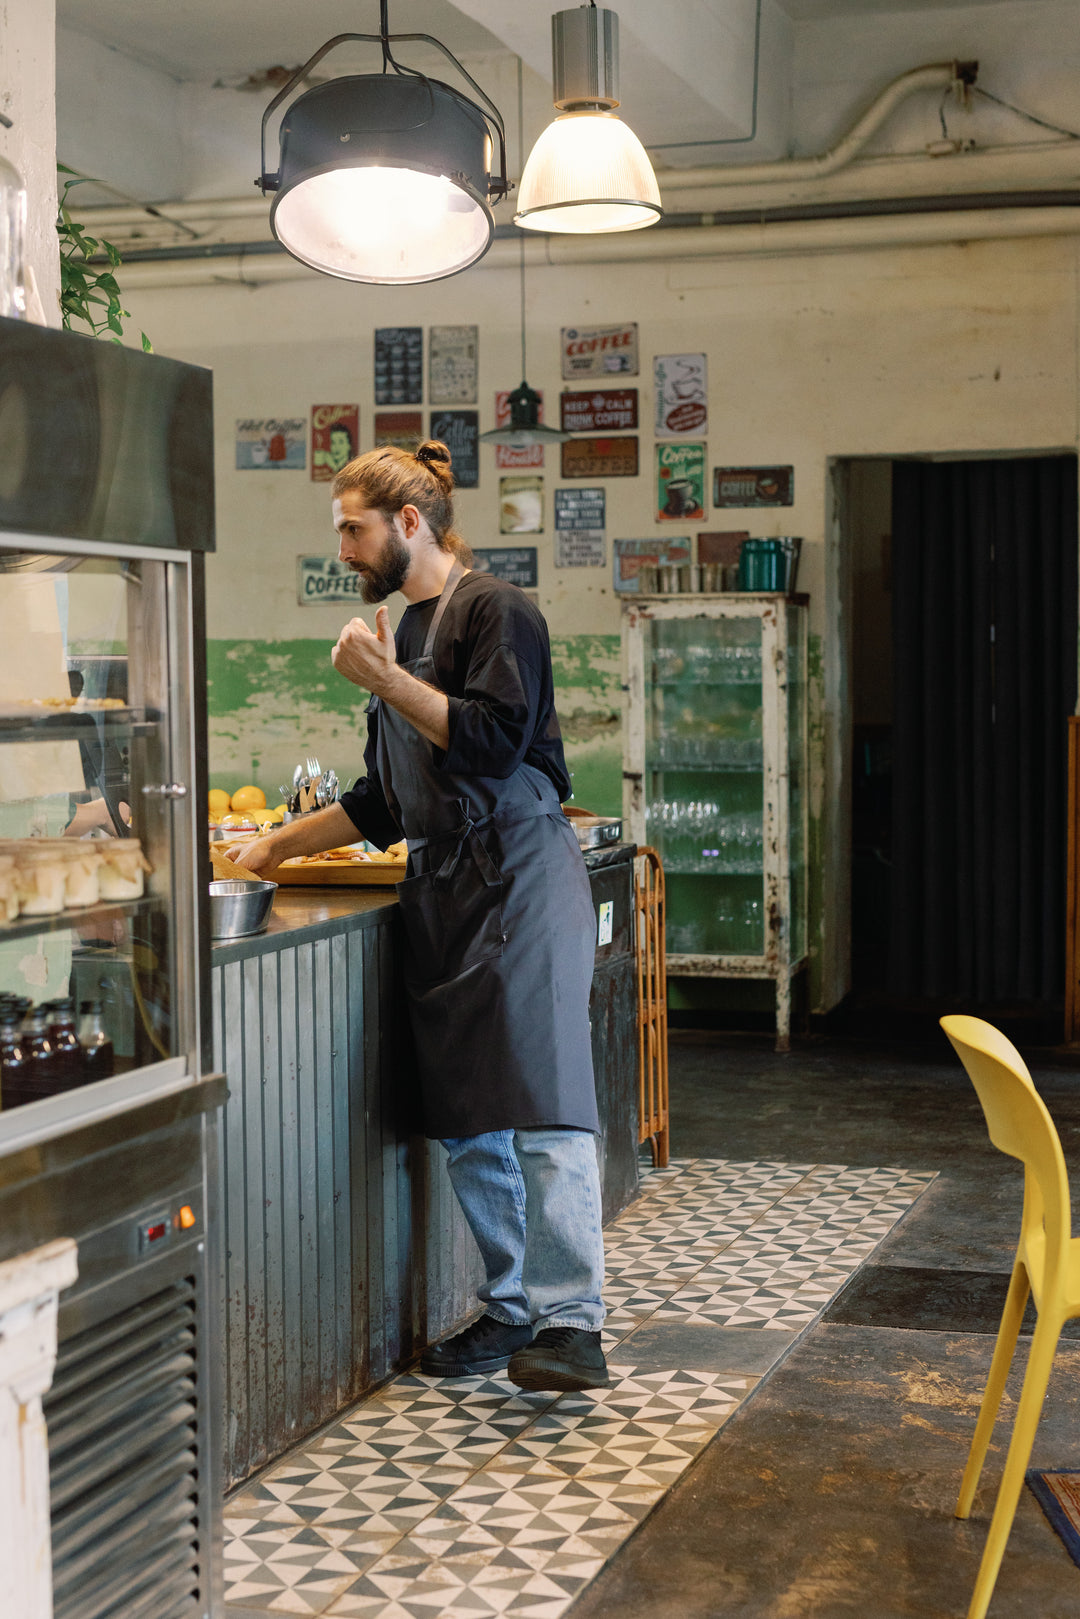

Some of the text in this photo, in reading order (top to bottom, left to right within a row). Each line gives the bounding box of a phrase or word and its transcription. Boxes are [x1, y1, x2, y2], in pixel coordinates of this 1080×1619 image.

[566, 333, 632, 356] COFFEE
[564, 400, 633, 412] KEEP CALM
[563, 411, 632, 426] DRINK COFFEE
[565, 456, 634, 473] COFFEE
[305, 573, 360, 595] COFFEE
